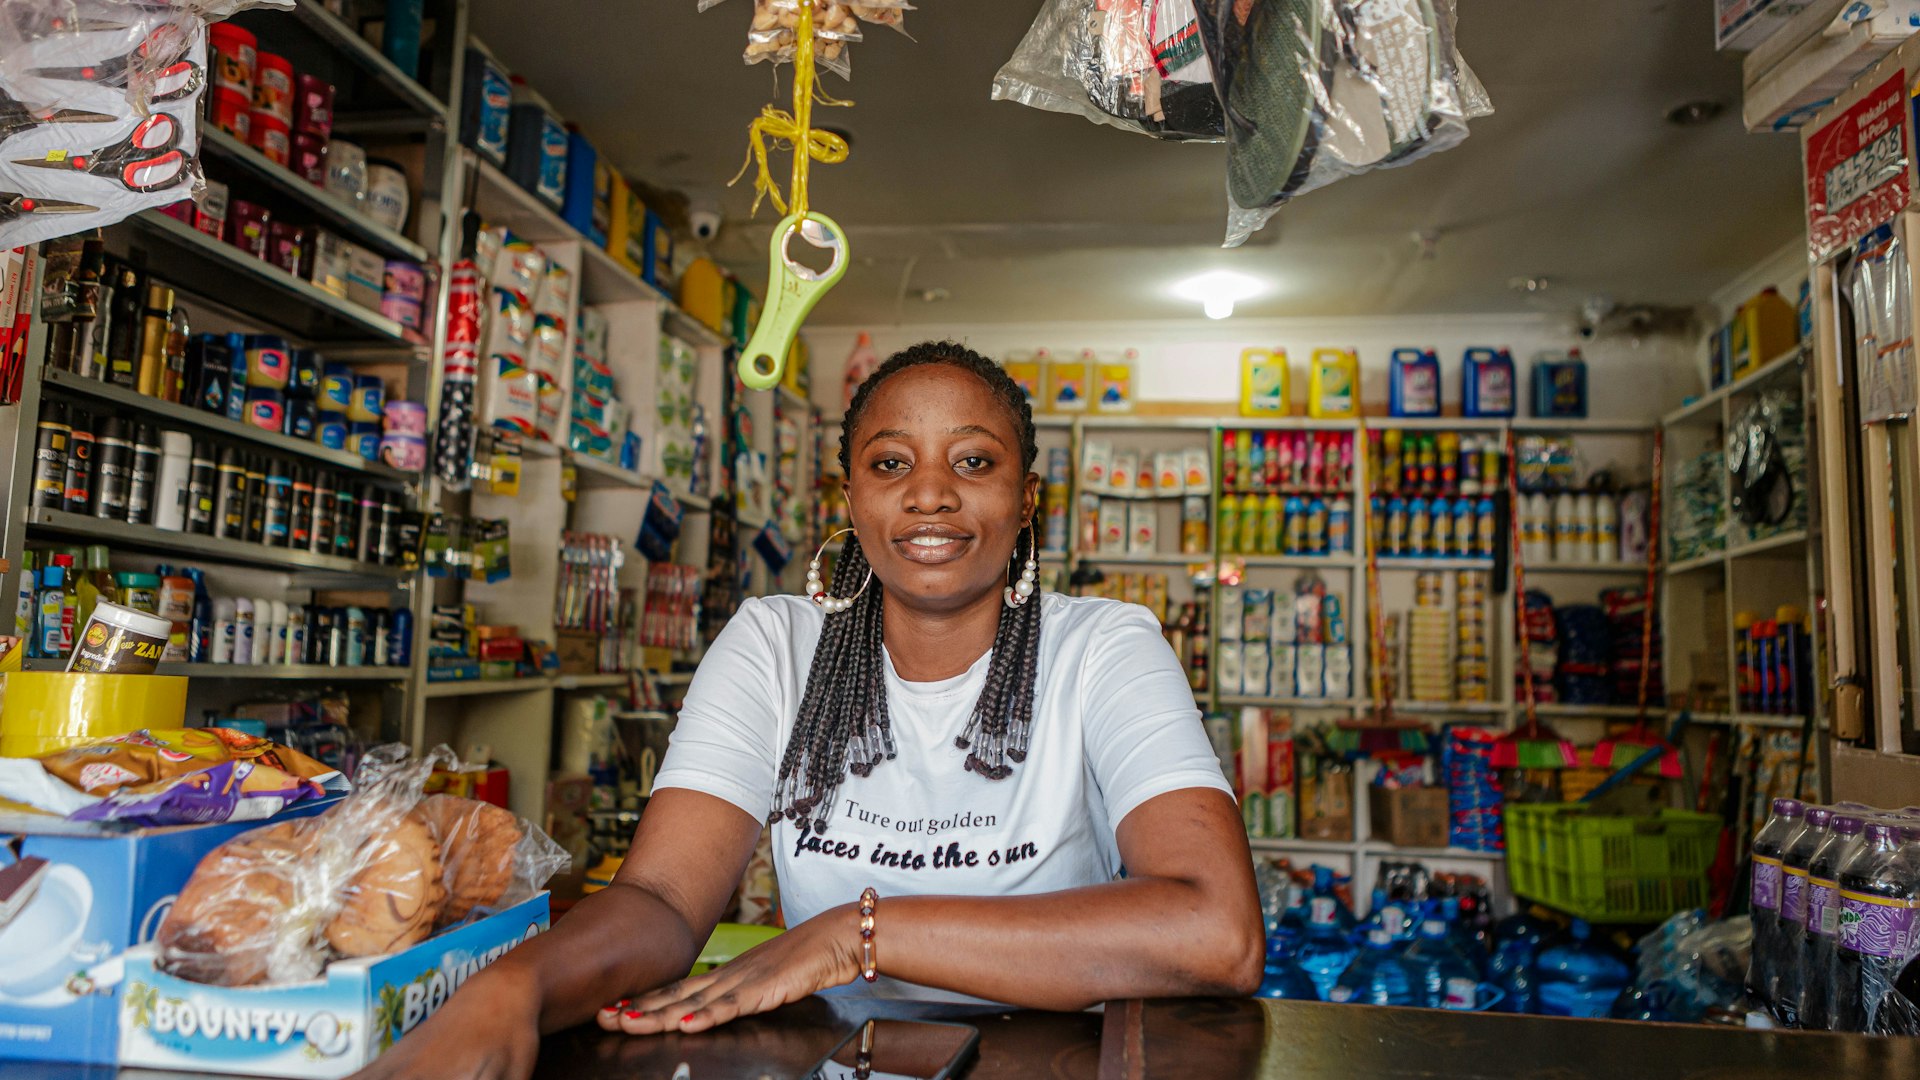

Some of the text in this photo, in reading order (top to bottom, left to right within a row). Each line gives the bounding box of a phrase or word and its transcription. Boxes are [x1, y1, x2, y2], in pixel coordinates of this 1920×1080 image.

[1858, 117, 1888, 147] M-Pesa
[6, 284, 15, 306] writing
[846, 799, 997, 836] Ture our golden
[793, 827, 861, 860] faces
[870, 842, 926, 871] into
[932, 841, 980, 869] the
[402, 938, 520, 1035] BOU
[155, 999, 299, 1045] BOUNTY
